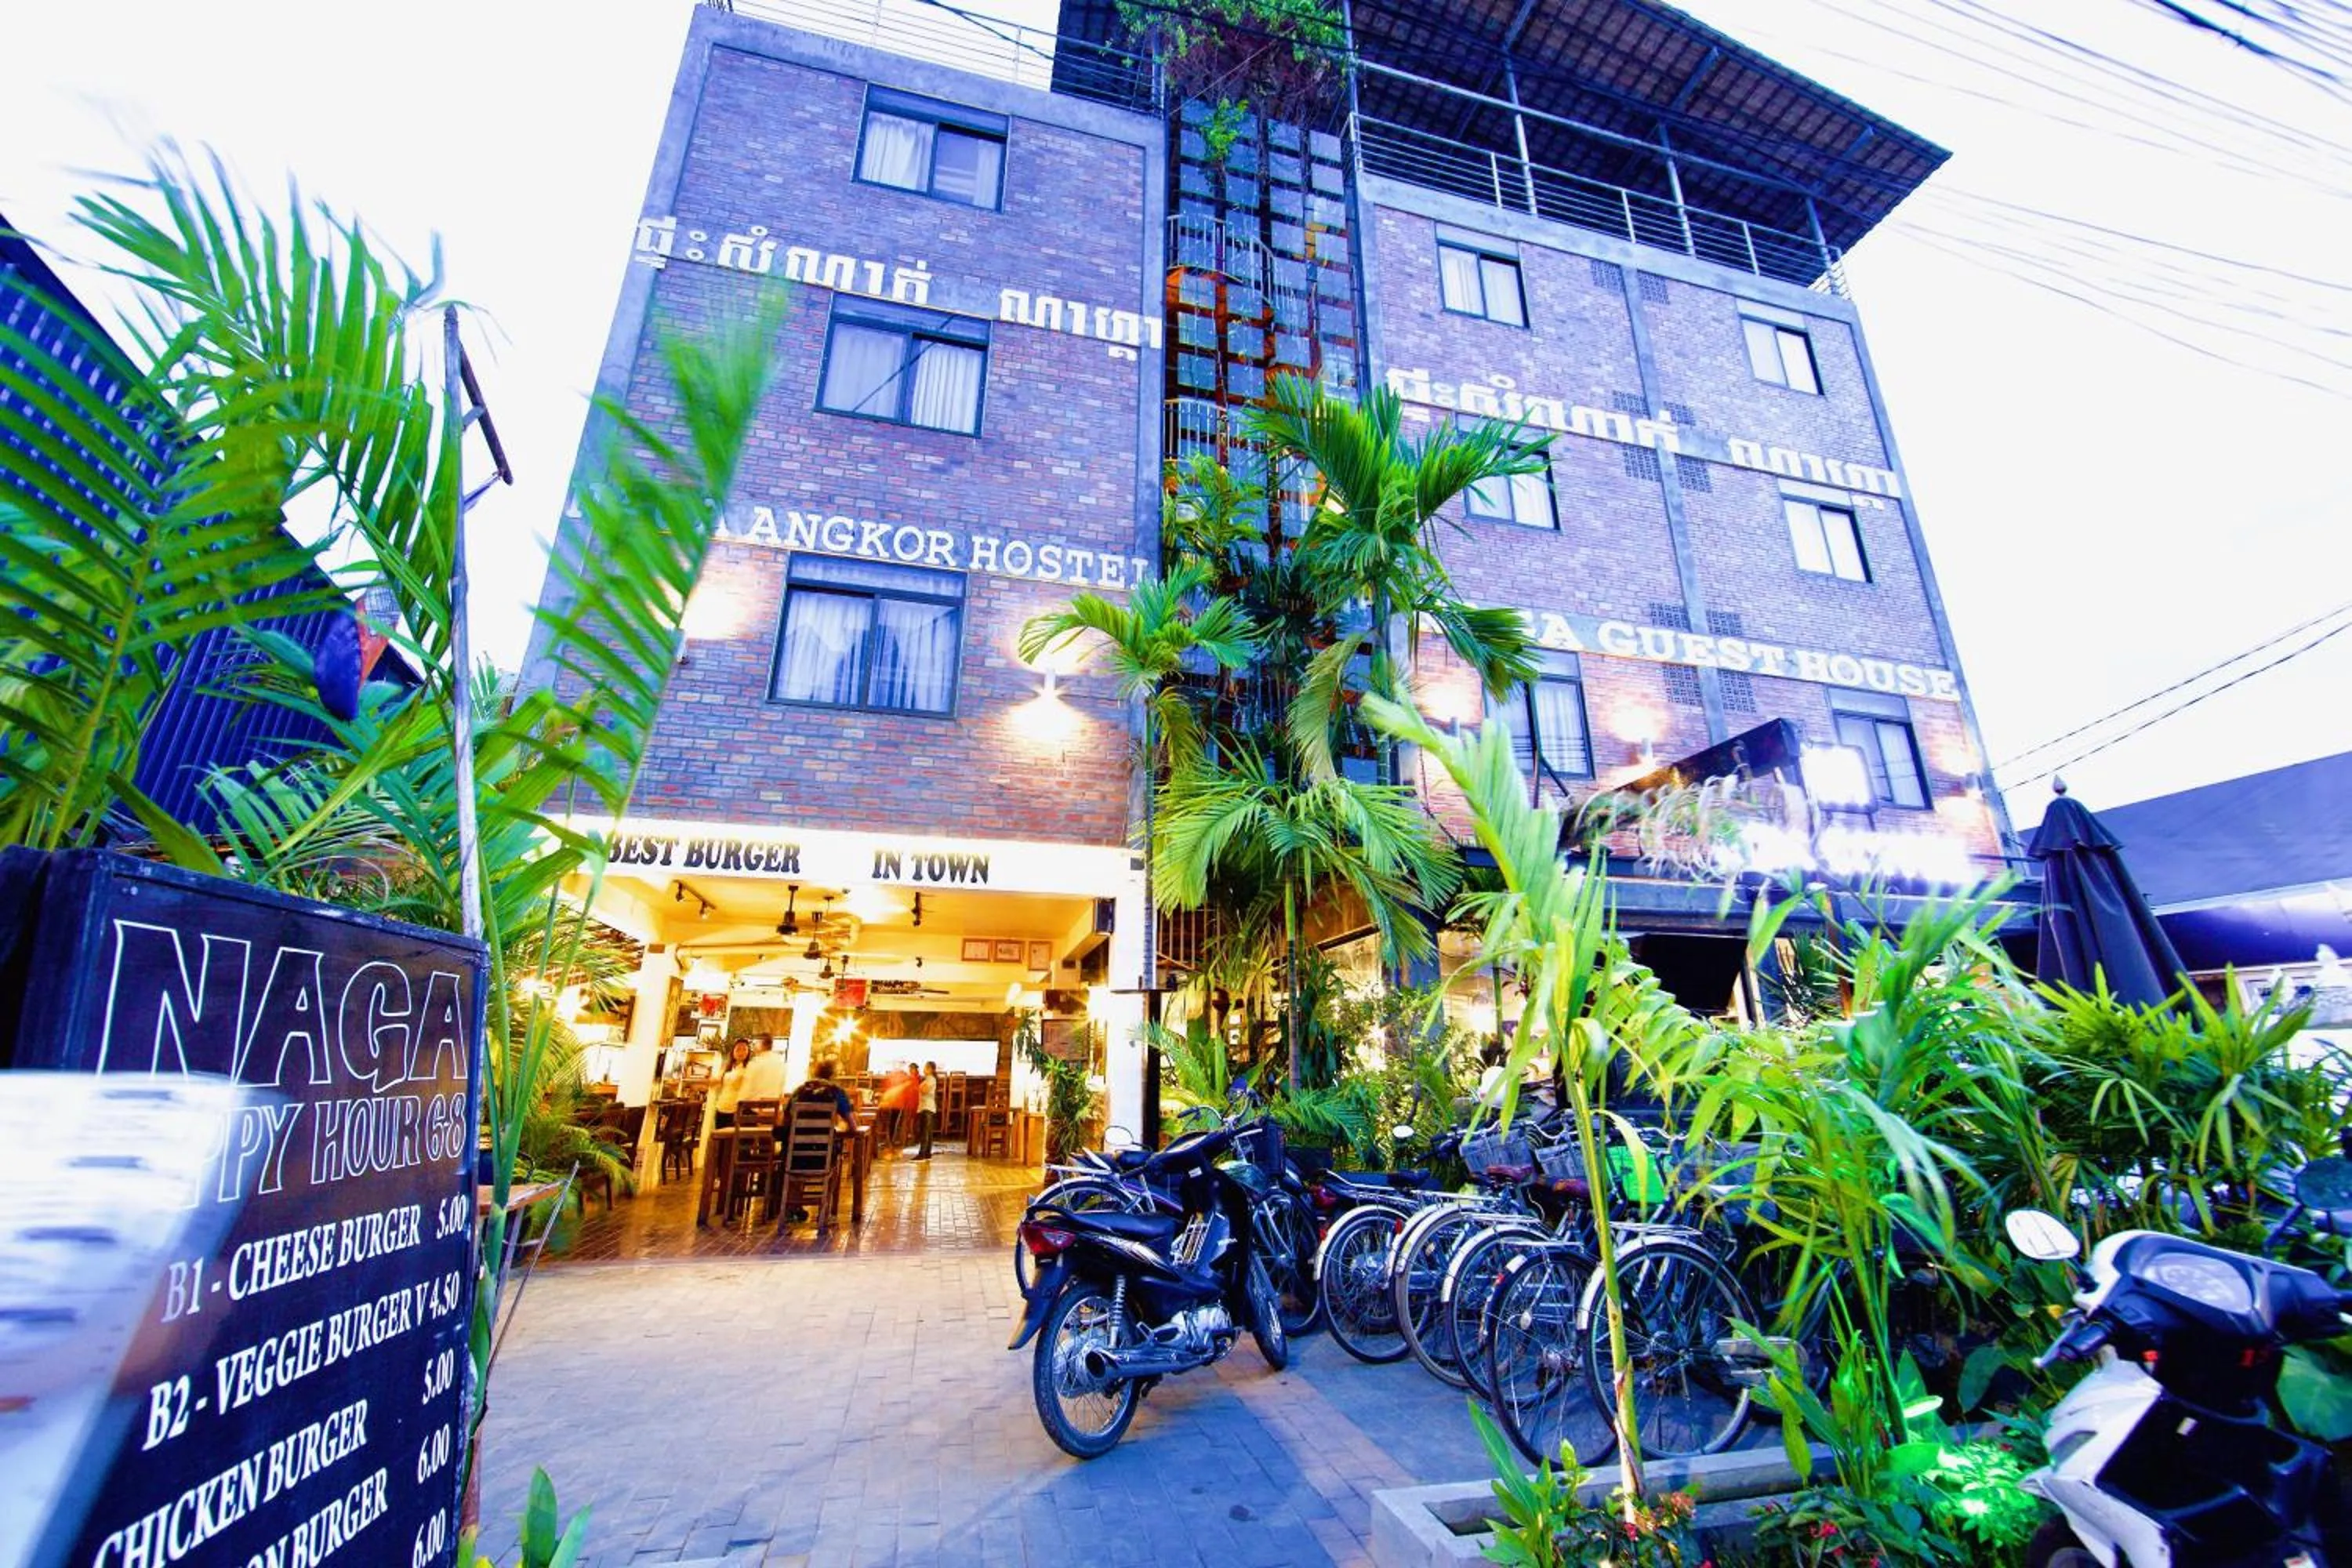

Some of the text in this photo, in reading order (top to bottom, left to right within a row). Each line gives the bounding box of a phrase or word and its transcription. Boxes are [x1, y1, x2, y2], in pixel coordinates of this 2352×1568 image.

[744, 506, 957, 567] ANGKOR
[1598, 620, 1786, 676] GUEST
[1794, 650, 1961, 701] HOUSE
[608, 831, 990, 885] BEST BURGER IN TOWN
[96, 918, 468, 1094] NAGA
[310, 1096, 421, 1185] HOUR
[162, 1257, 204, 1323] B1
[229, 1221, 336, 1301] CHEESE
[337, 1203, 421, 1270] BURGER
[436, 1195, 466, 1240] 5.00
[142, 1374, 191, 1451] B2
[216, 1319, 323, 1415] VEGGIE
[324, 1287, 412, 1367] BURGER
[415, 1280, 429, 1327] V
[429, 1270, 460, 1319] 4.50
[263, 1399, 368, 1503] BURGER
[422, 1348, 454, 1405] 5.00
[292, 1467, 388, 1568] BURGER
[417, 1424, 450, 1484] 6.00
[412, 1508, 446, 1568] 6.00
